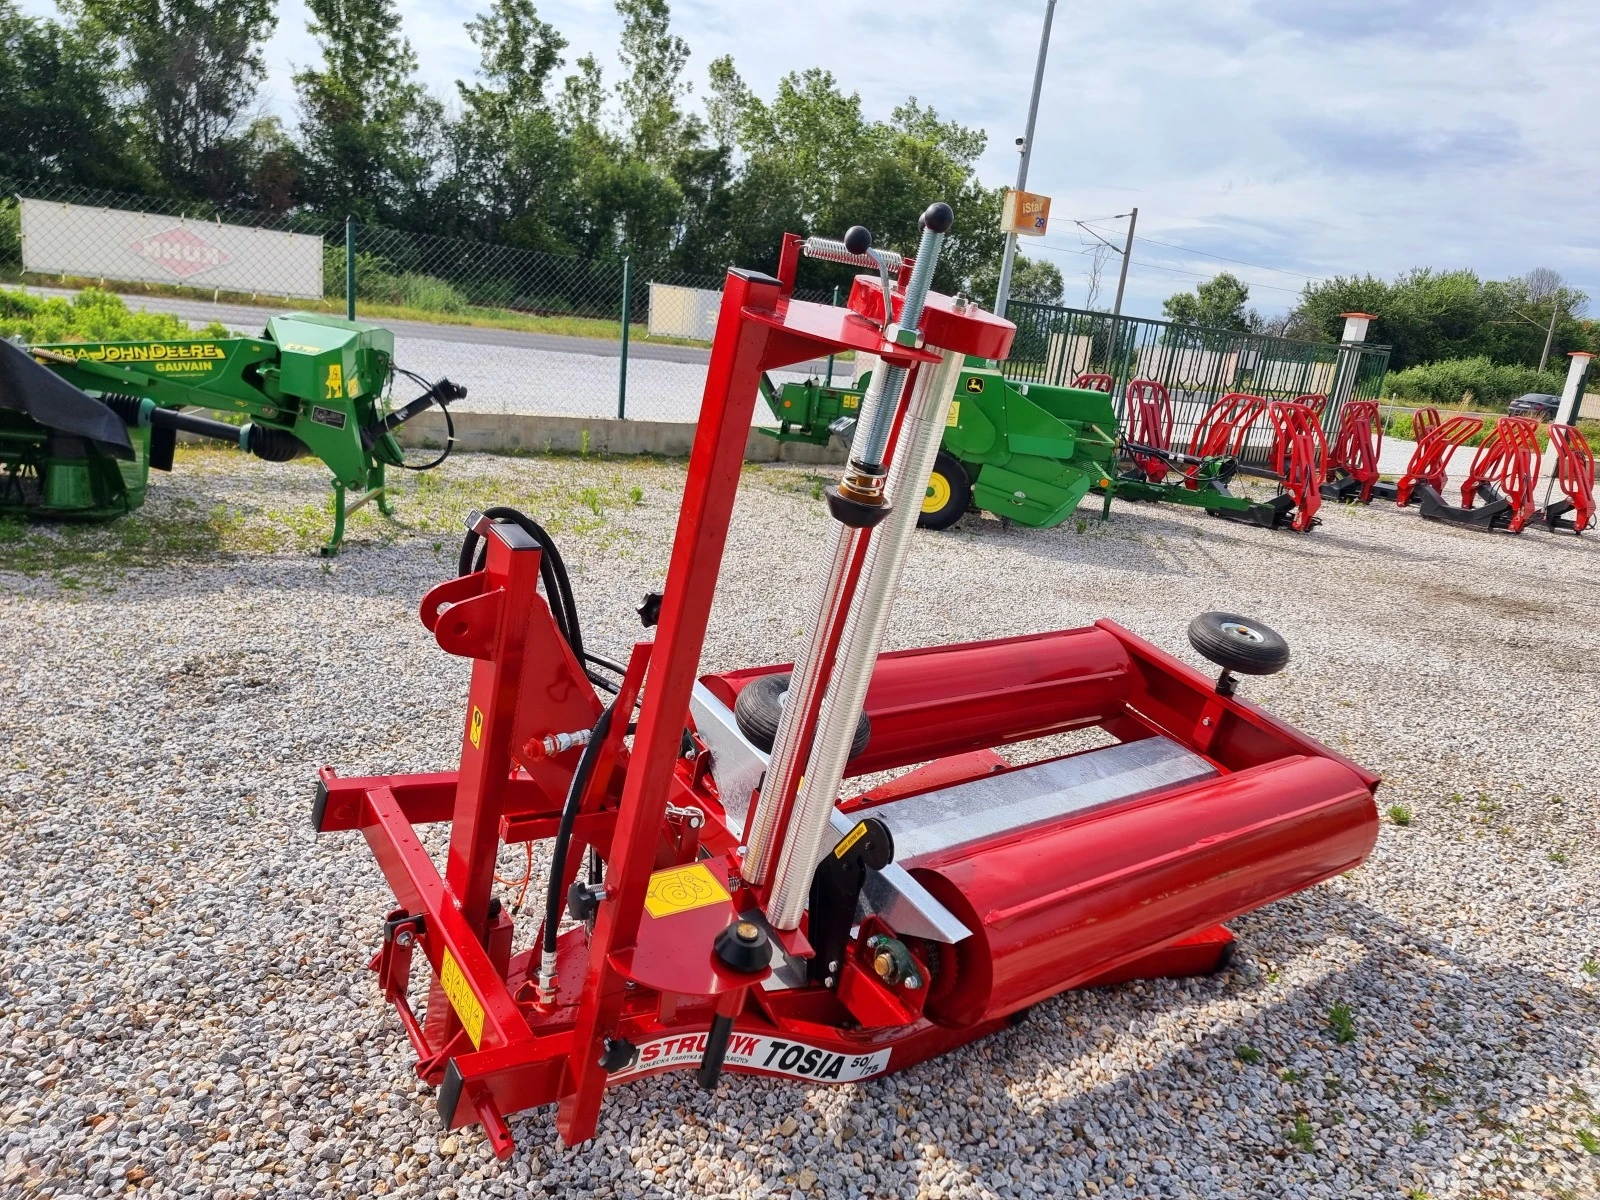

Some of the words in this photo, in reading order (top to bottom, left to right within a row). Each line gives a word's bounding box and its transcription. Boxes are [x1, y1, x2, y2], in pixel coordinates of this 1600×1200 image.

[1022, 202, 1044, 214] iStar
[94, 344, 151, 361] JOHN
[150, 343, 217, 359] DEERE
[155, 361, 213, 372] GAUVAIN
[639, 1057, 670, 1070] SOLECKA
[762, 1040, 846, 1080] TOSIA
